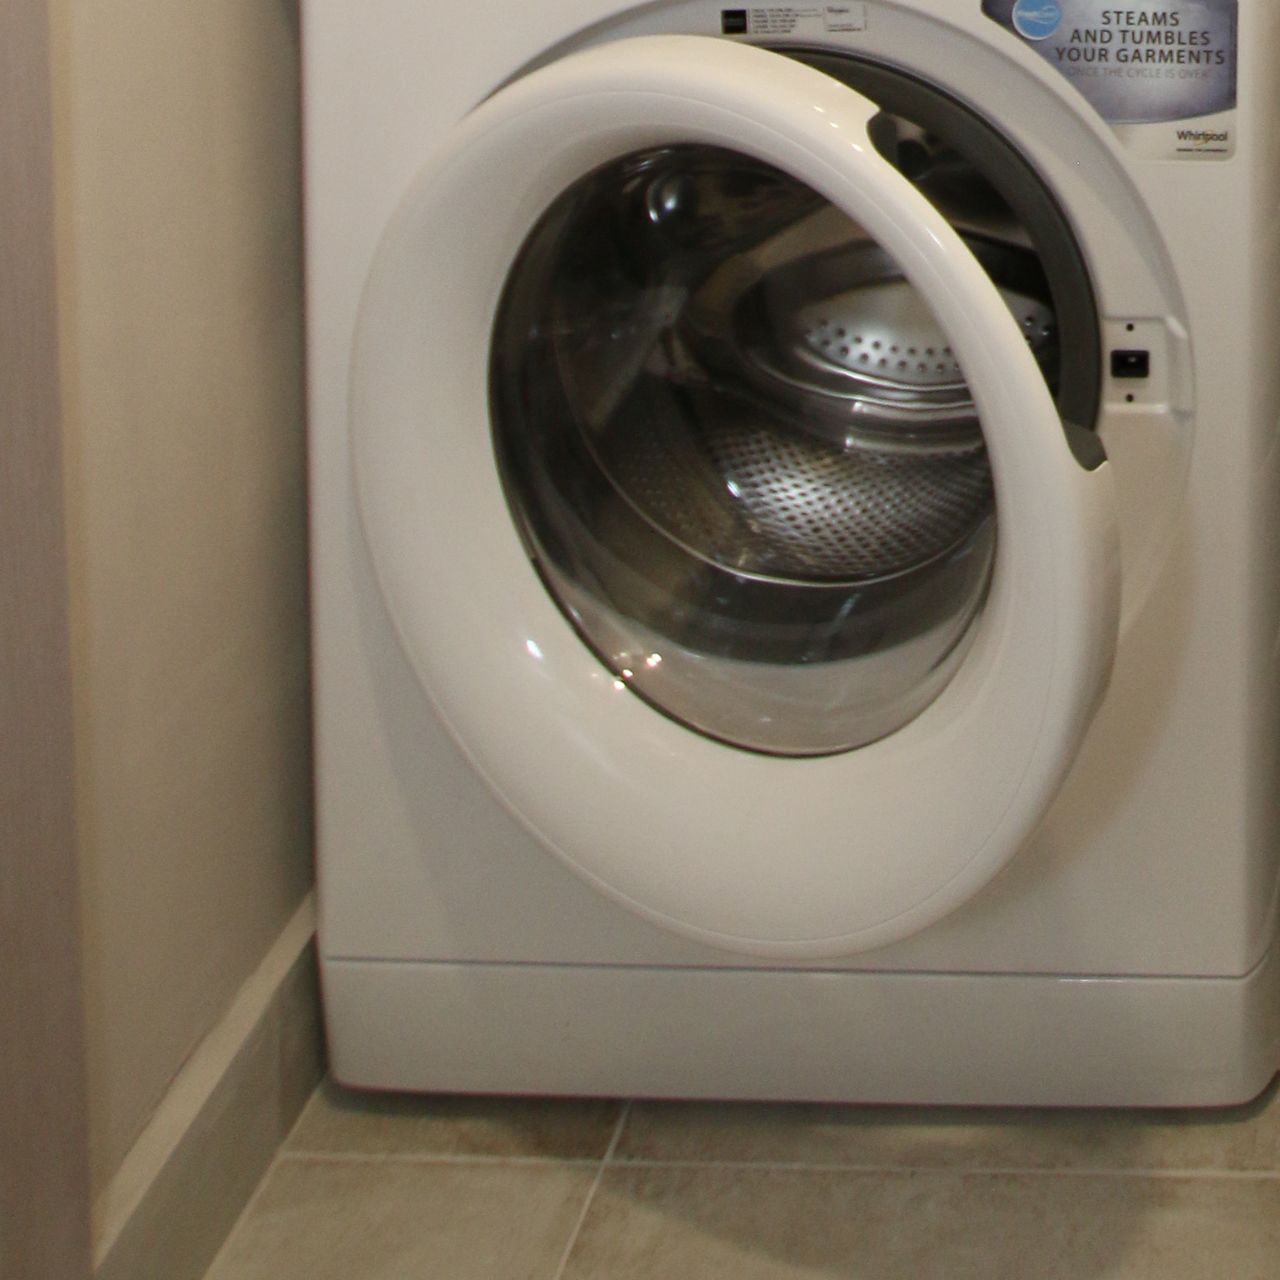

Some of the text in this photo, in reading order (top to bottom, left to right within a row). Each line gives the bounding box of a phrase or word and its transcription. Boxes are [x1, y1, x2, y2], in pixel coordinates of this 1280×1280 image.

[1101, 11, 1180, 26] STEAMS
[1070, 29, 1211, 45] AND TUMBLES
[1056, 47, 1225, 65] YOUR GARMENTS
[1104, 67, 1123, 78] THE
[1127, 68, 1161, 79] CYCLE
[1165, 68, 1175, 79] IS
[1178, 68, 1208, 80] OVER
[1177, 130, 1228, 143] Whirlpool
